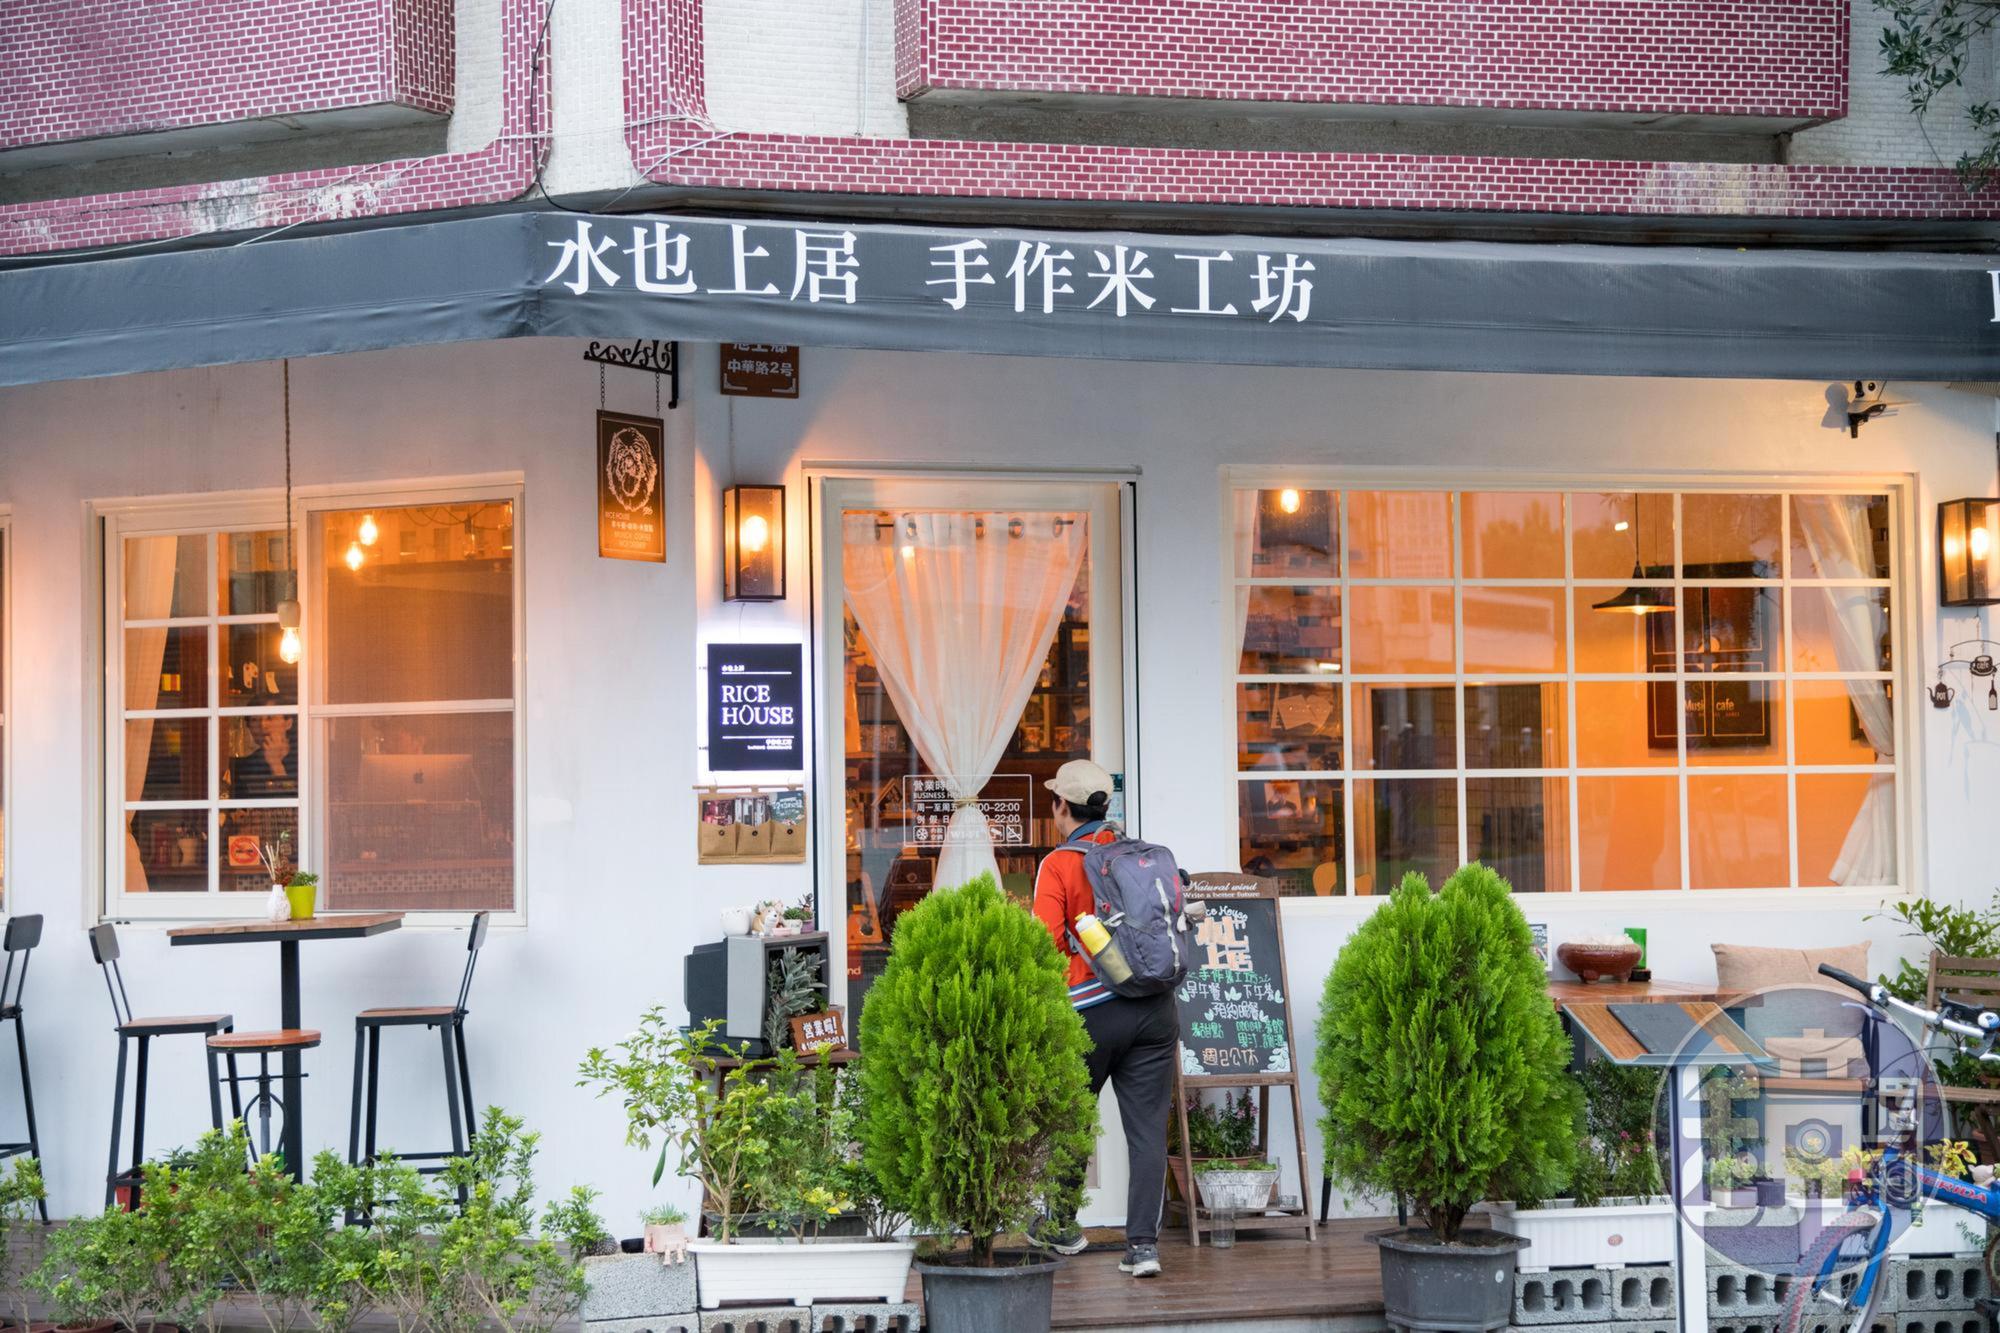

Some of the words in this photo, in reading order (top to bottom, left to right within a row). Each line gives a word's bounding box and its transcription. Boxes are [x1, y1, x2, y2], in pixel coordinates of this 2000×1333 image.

[544, 219, 861, 304] 水也上居
[924, 238, 1317, 324] 手作米工坊
[721, 684, 771, 704] RICE
[1936, 692, 1946, 701] POT
[721, 704, 794, 726] HOUSE
[913, 791, 946, 799] BUSINESS
[1182, 879, 1231, 892] Natural
[1231, 881, 1259, 892] wind
